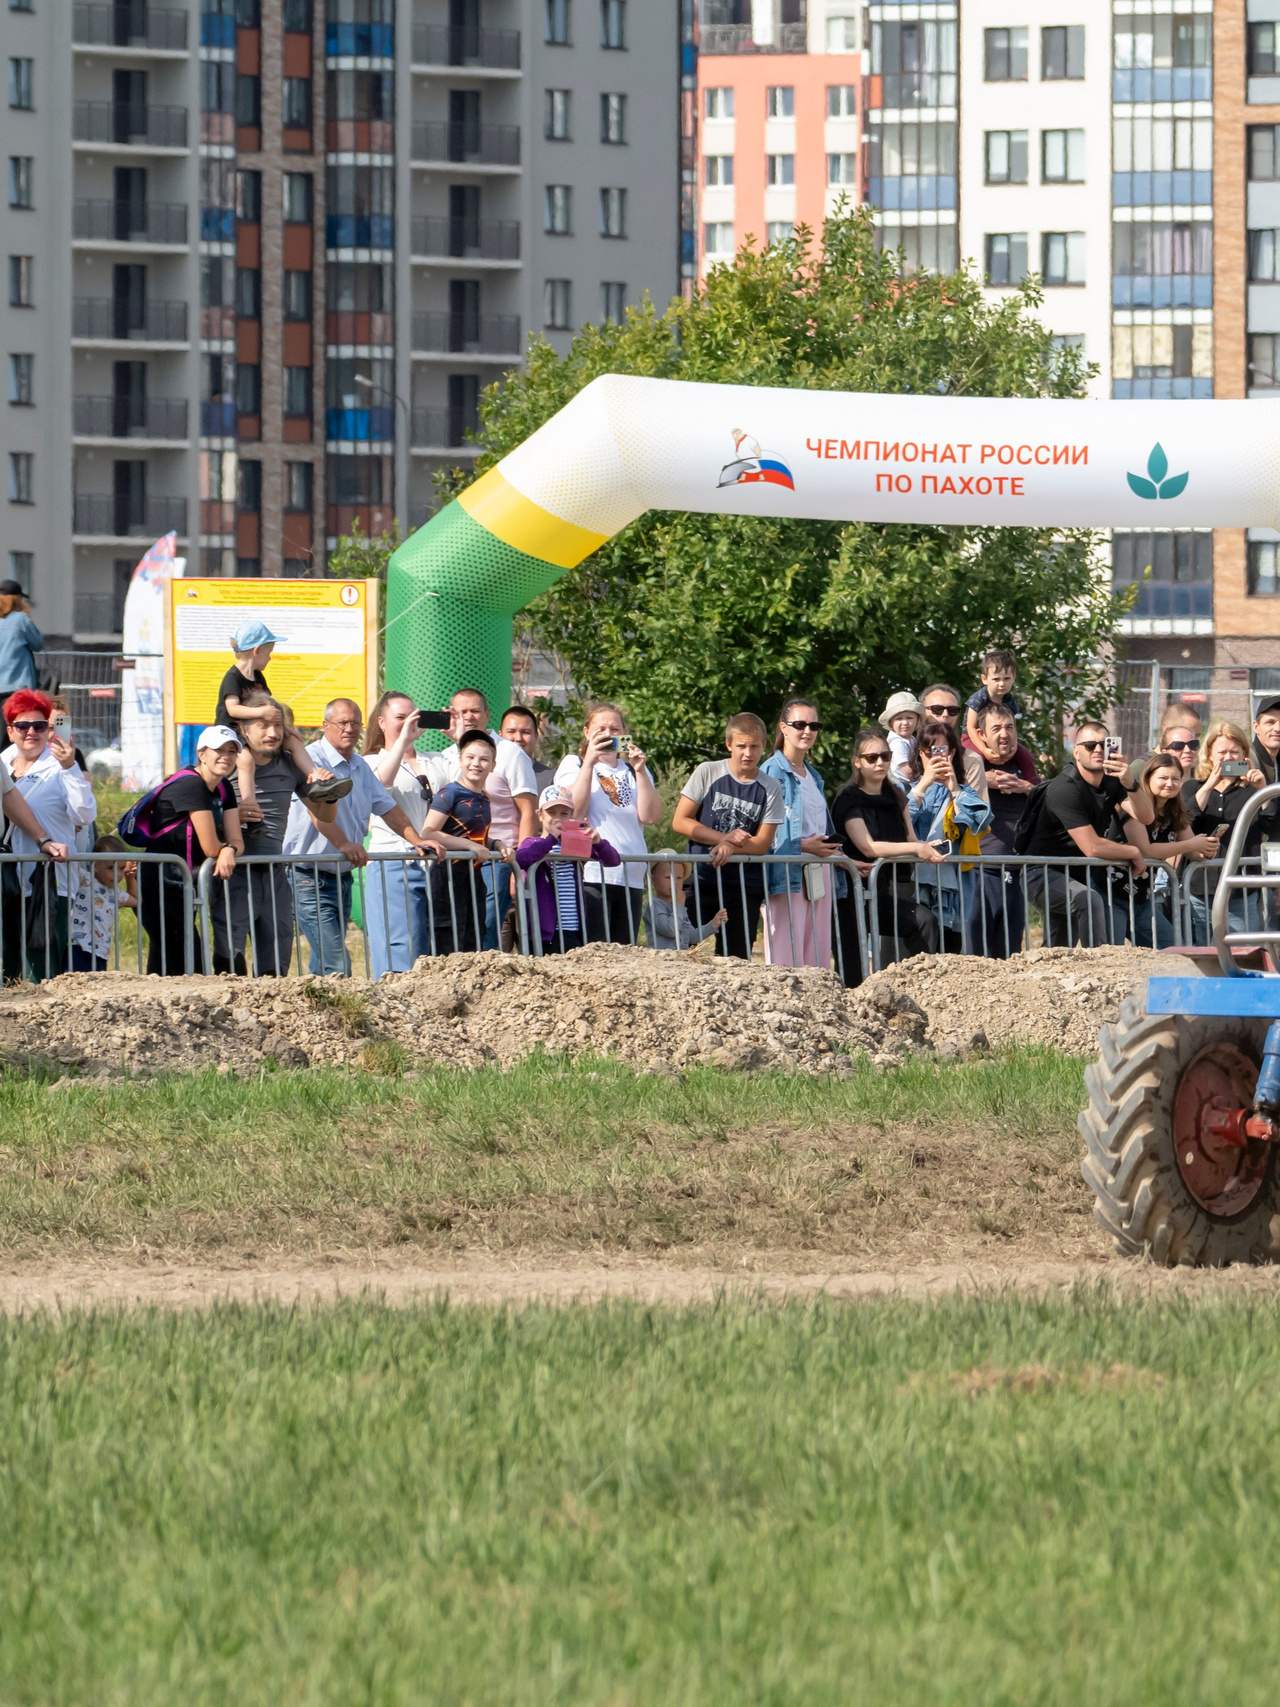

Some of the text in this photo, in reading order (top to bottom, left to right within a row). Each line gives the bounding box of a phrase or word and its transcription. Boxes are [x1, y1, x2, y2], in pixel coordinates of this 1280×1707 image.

[806, 438, 1089, 465] ЧЕМПИОНАТ РОССИИ
[876, 473, 1025, 495] ПО ПАХОТЕ
